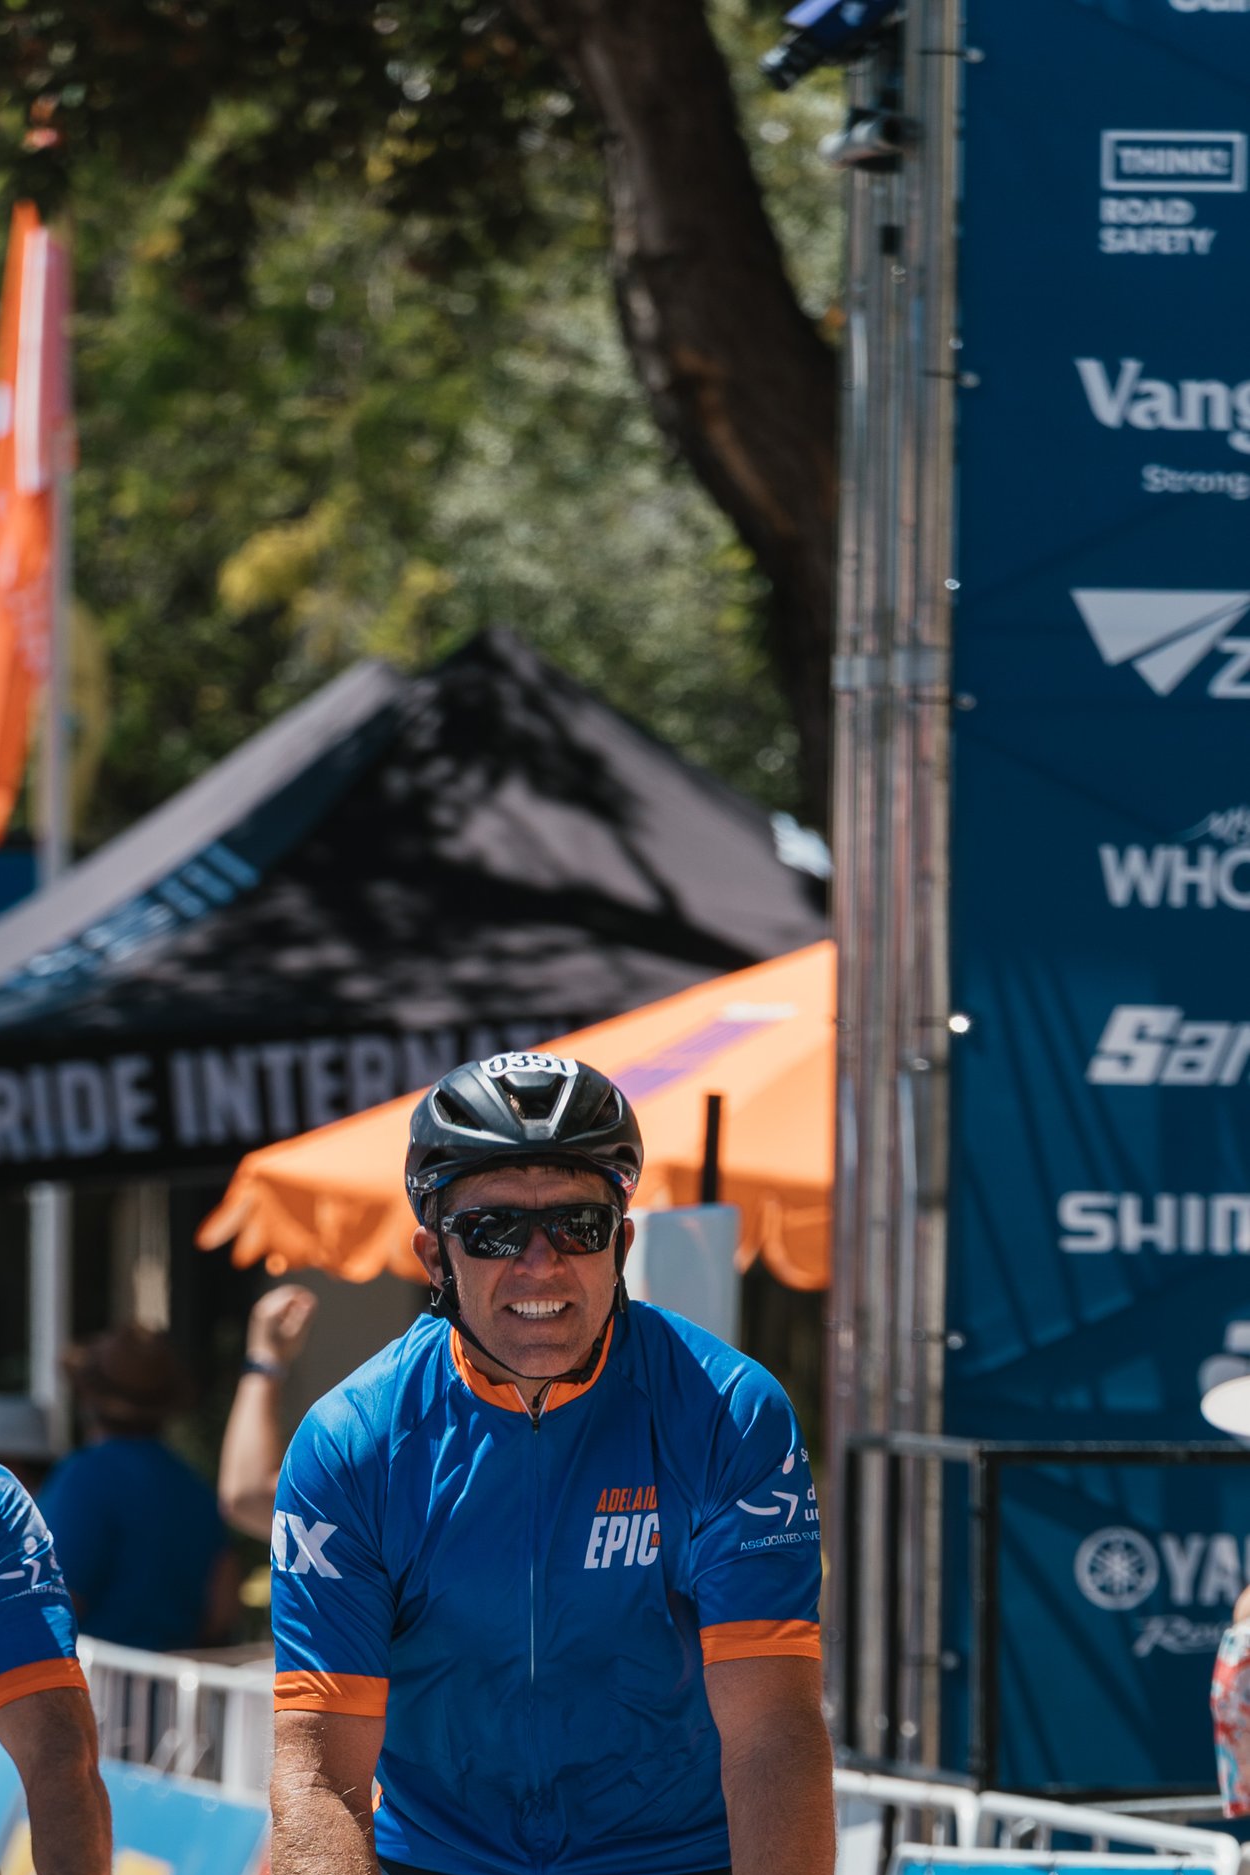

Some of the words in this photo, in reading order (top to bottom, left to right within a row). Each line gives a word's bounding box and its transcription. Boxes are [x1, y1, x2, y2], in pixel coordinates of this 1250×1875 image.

[1100, 198, 1196, 225] ROAD
[1099, 227, 1217, 255] SAFETY
[583, 1512, 660, 1570] EPIC
[740, 1532, 802, 1553] ASSOCIATED
[1160, 1532, 1250, 1607] YA
